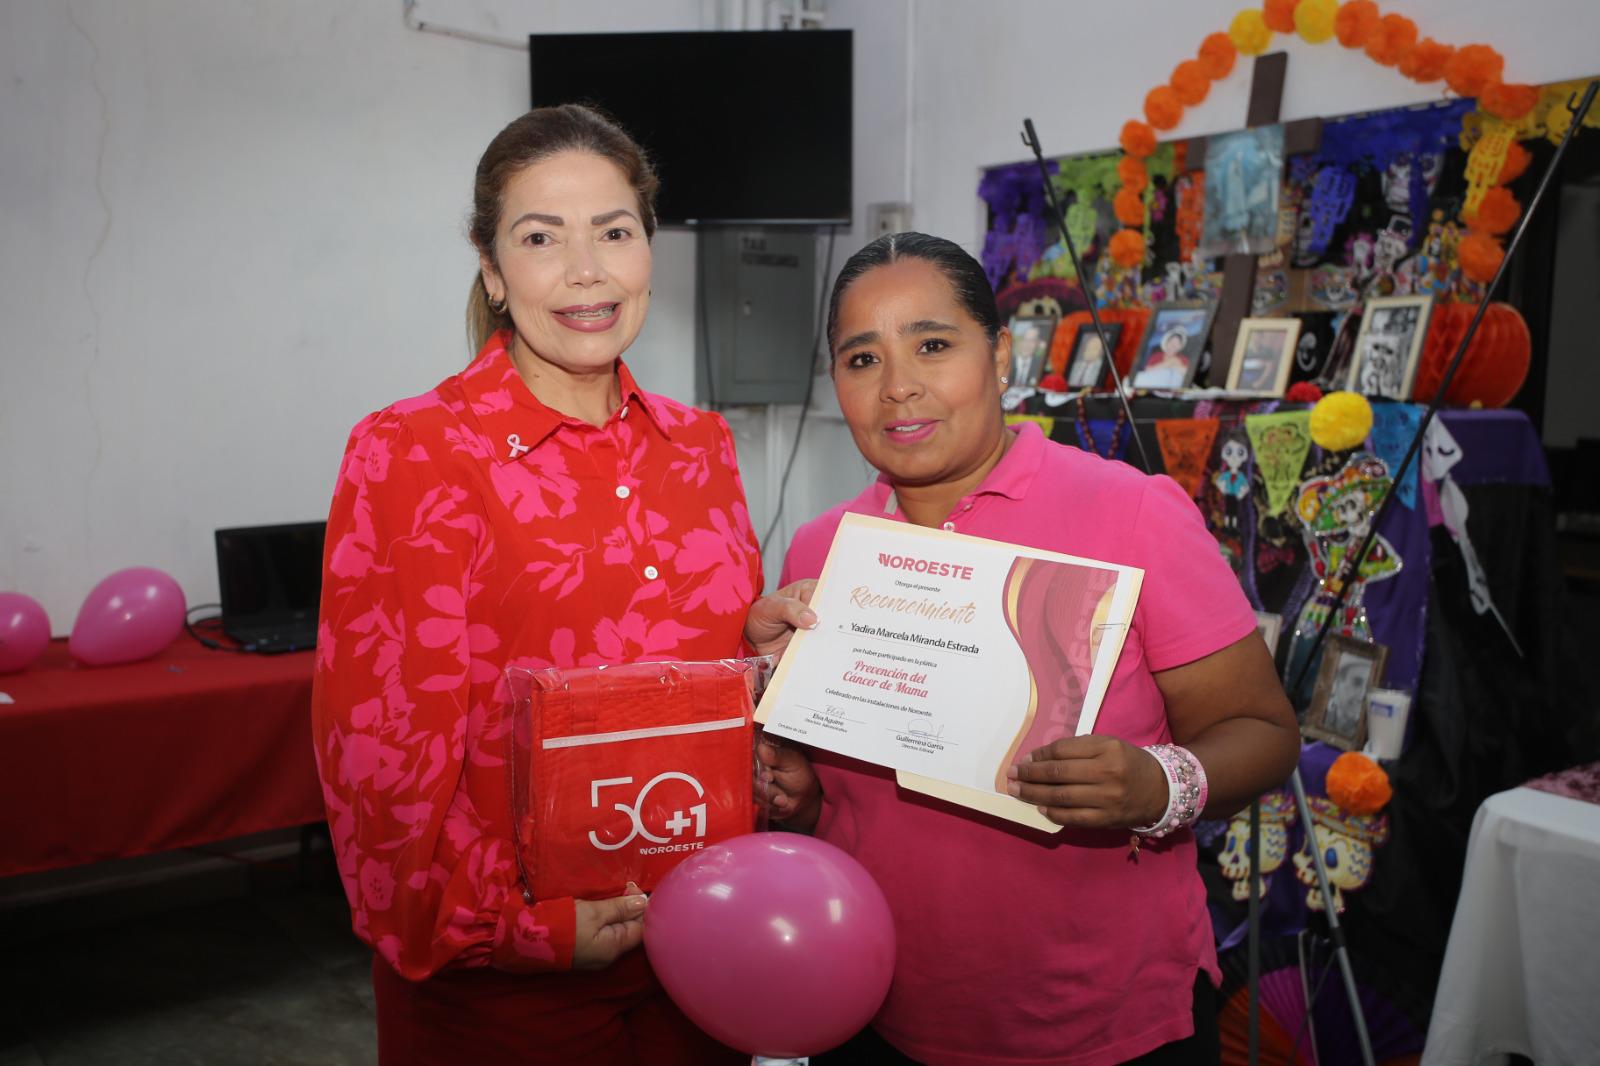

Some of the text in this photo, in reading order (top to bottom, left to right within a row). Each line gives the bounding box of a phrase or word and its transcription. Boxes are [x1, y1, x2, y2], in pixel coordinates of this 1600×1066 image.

[878, 553, 973, 580] NOROESTE
[894, 580, 913, 589] Otorga
[918, 584, 942, 593] presente
[850, 585, 976, 624] Reconocimiento
[851, 622, 876, 635] Yadira
[876, 627, 909, 641] Marcela
[909, 633, 946, 648] Miranda
[946, 640, 980, 654] Estrada
[862, 648, 877, 656] haber
[877, 652, 907, 662] participado
[842, 671, 929, 698] Cáncer de Mama
[854, 660, 928, 685] Prevención del
[825, 688, 852, 699] Celebrado
[867, 699, 900, 711] instalaciones
[896, 735, 927, 747] Guillermina
[640, 841, 705, 856] NOROESTE
